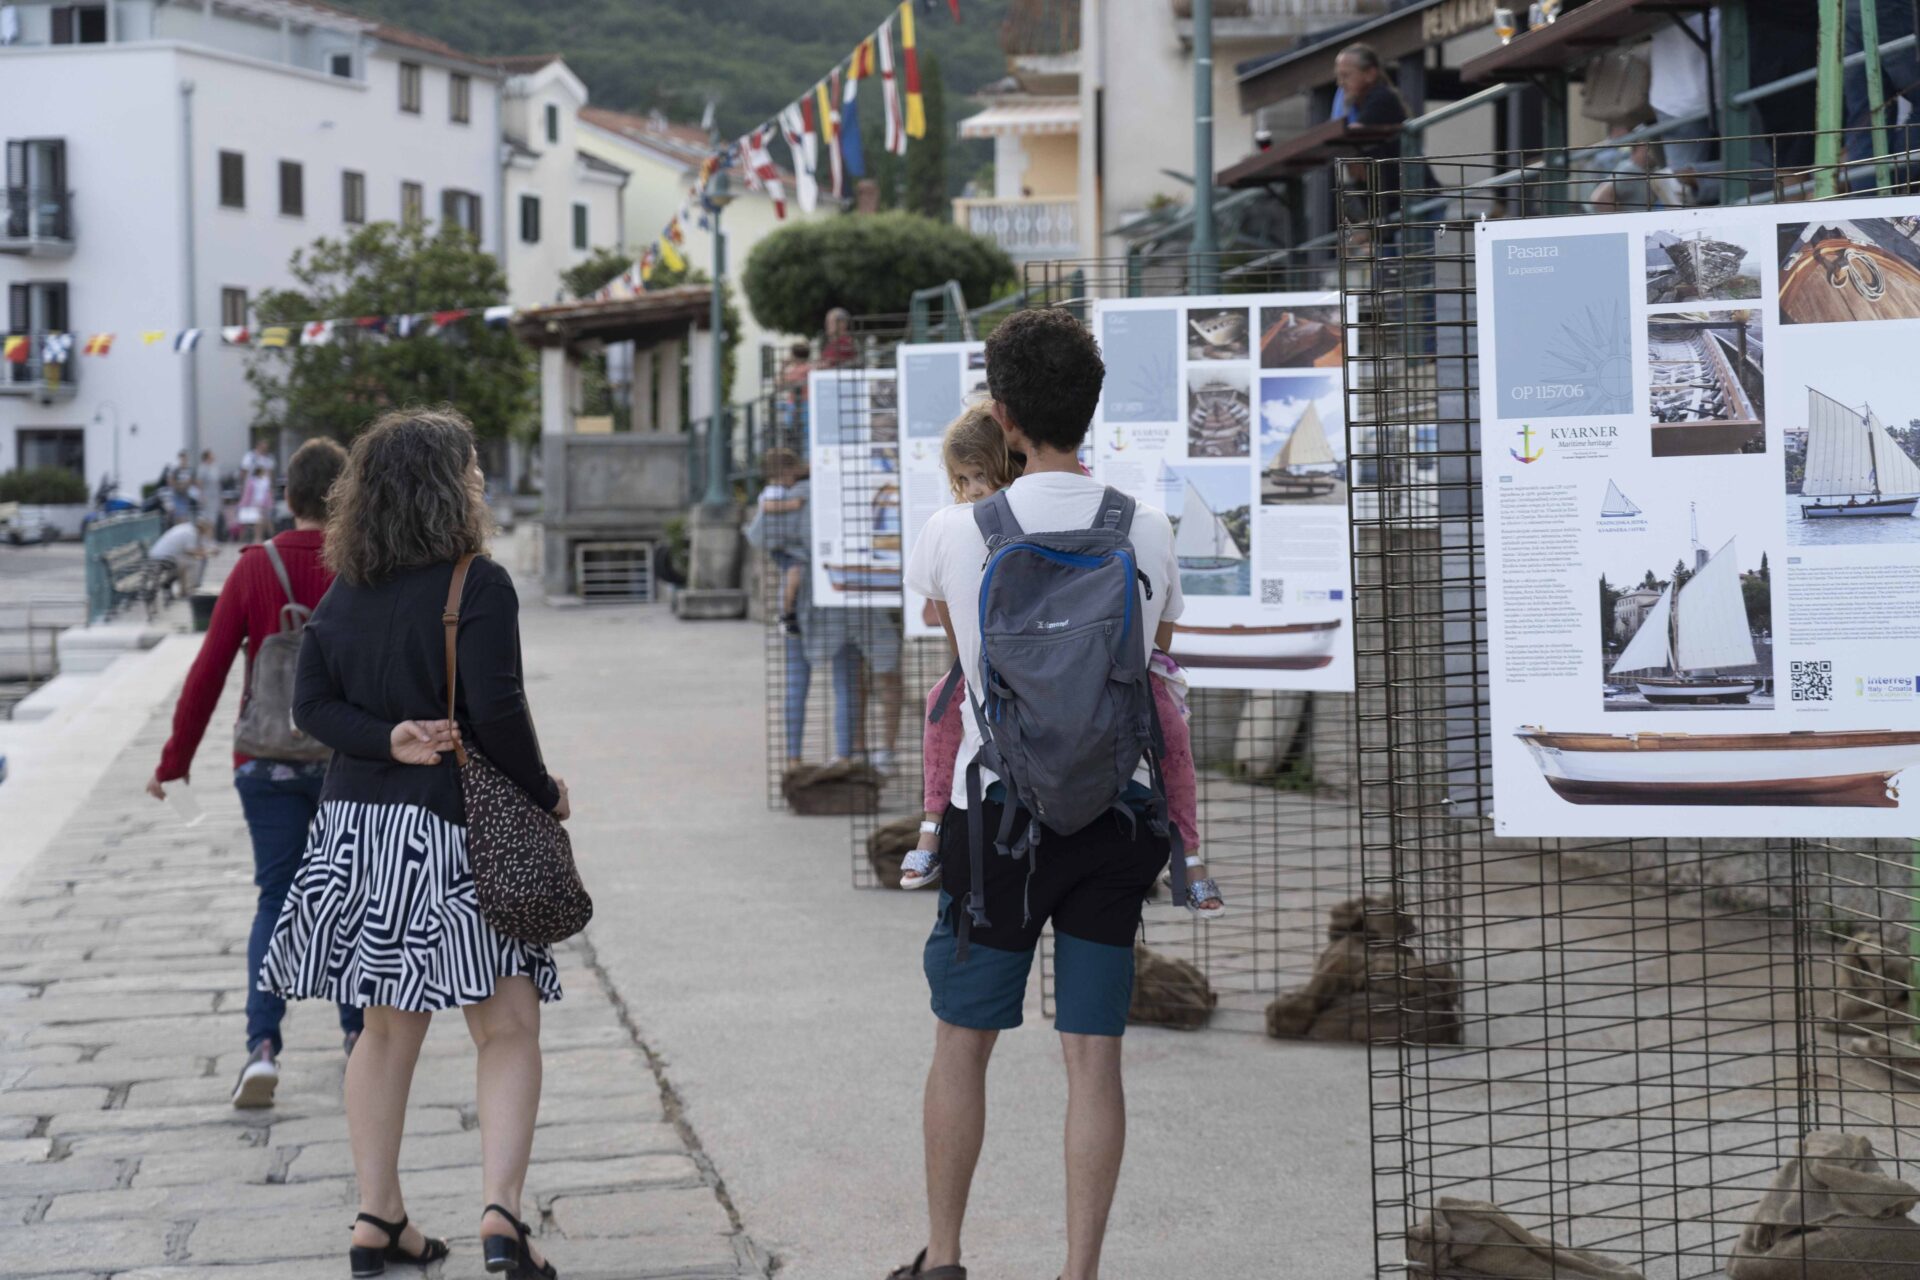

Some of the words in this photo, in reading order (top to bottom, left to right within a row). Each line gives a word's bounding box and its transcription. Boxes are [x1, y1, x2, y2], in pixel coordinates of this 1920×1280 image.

[1507, 245, 1559, 259] Pasara
[1508, 266, 1519, 275] La
[1520, 265, 1554, 276] passera
[1511, 386, 1533, 400] OP
[1535, 384, 1584, 399] 115706
[1550, 426, 1619, 439] KVARNER
[1558, 440, 1586, 448] Maritime
[1587, 439, 1613, 448] heritage
[1867, 676, 1912, 686] Interreg
